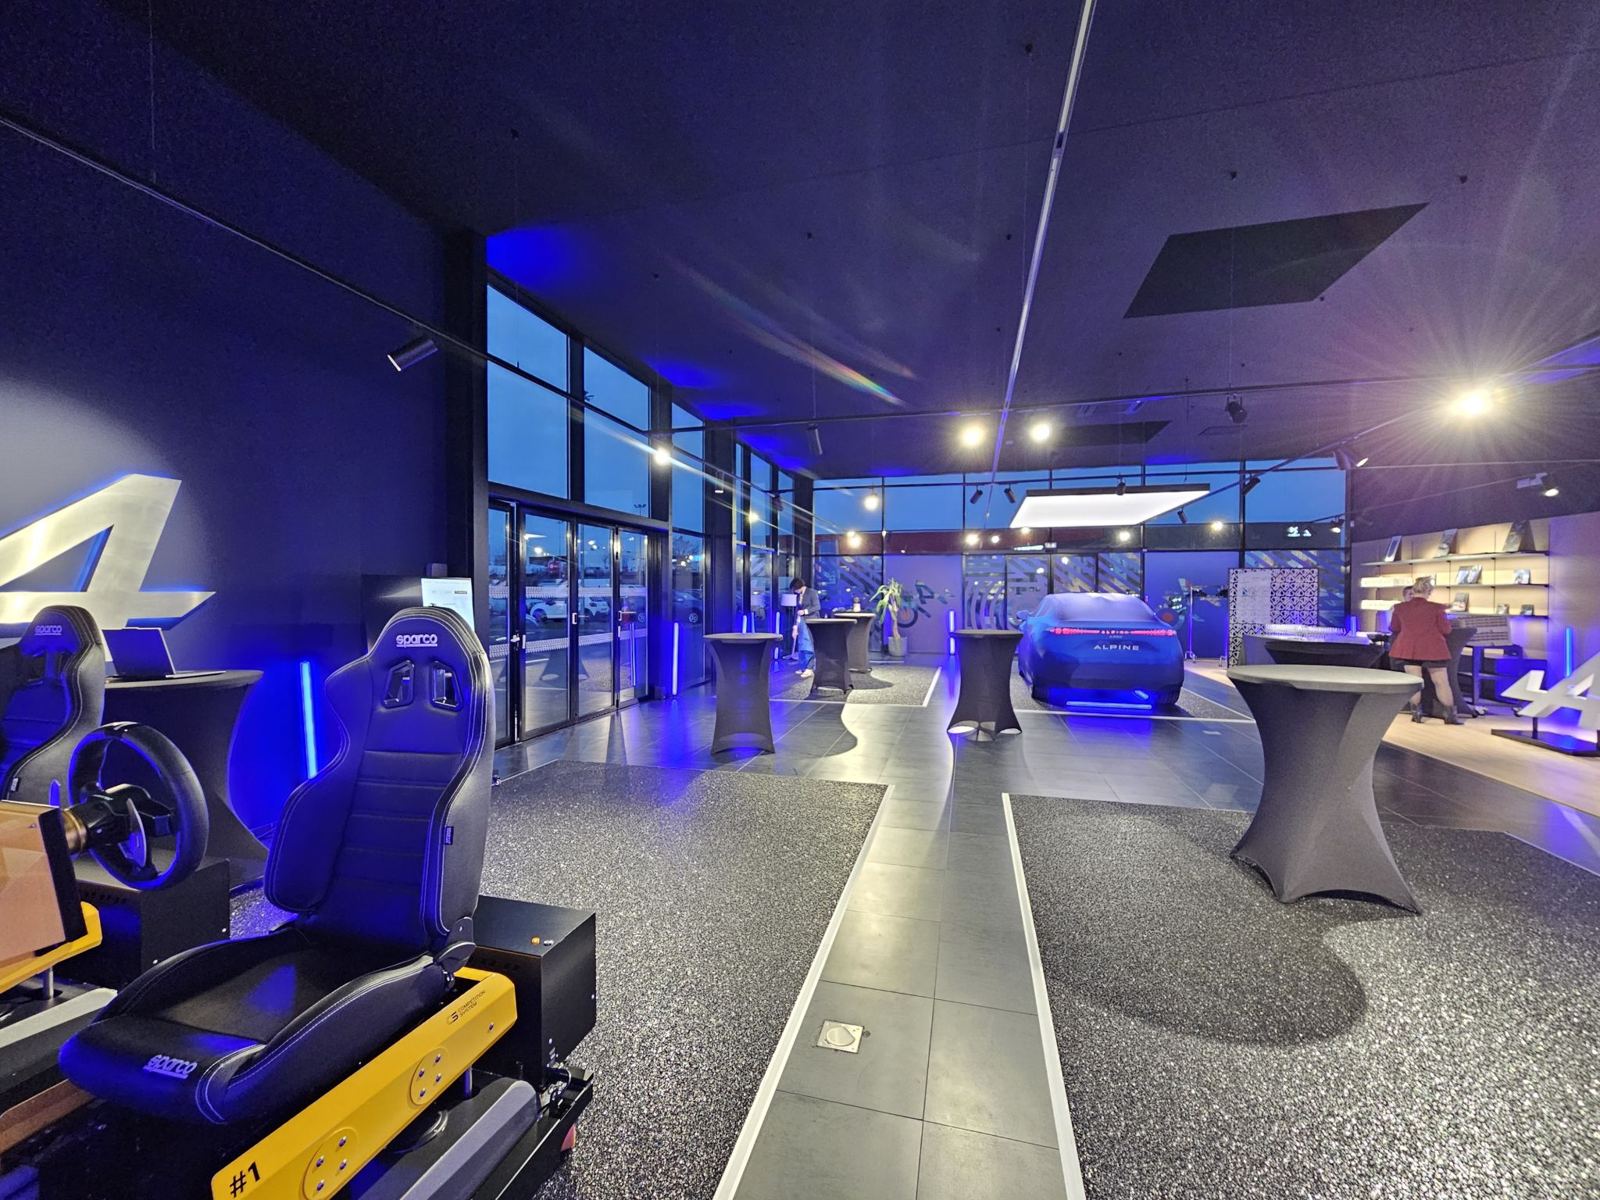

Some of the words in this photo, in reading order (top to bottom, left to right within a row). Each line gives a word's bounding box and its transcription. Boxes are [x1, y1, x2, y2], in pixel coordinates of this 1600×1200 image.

[35, 625, 63, 635] sparco
[396, 633, 438, 647] sparco
[145, 1054, 198, 1077] sparco
[229, 1161, 261, 1198] #1
